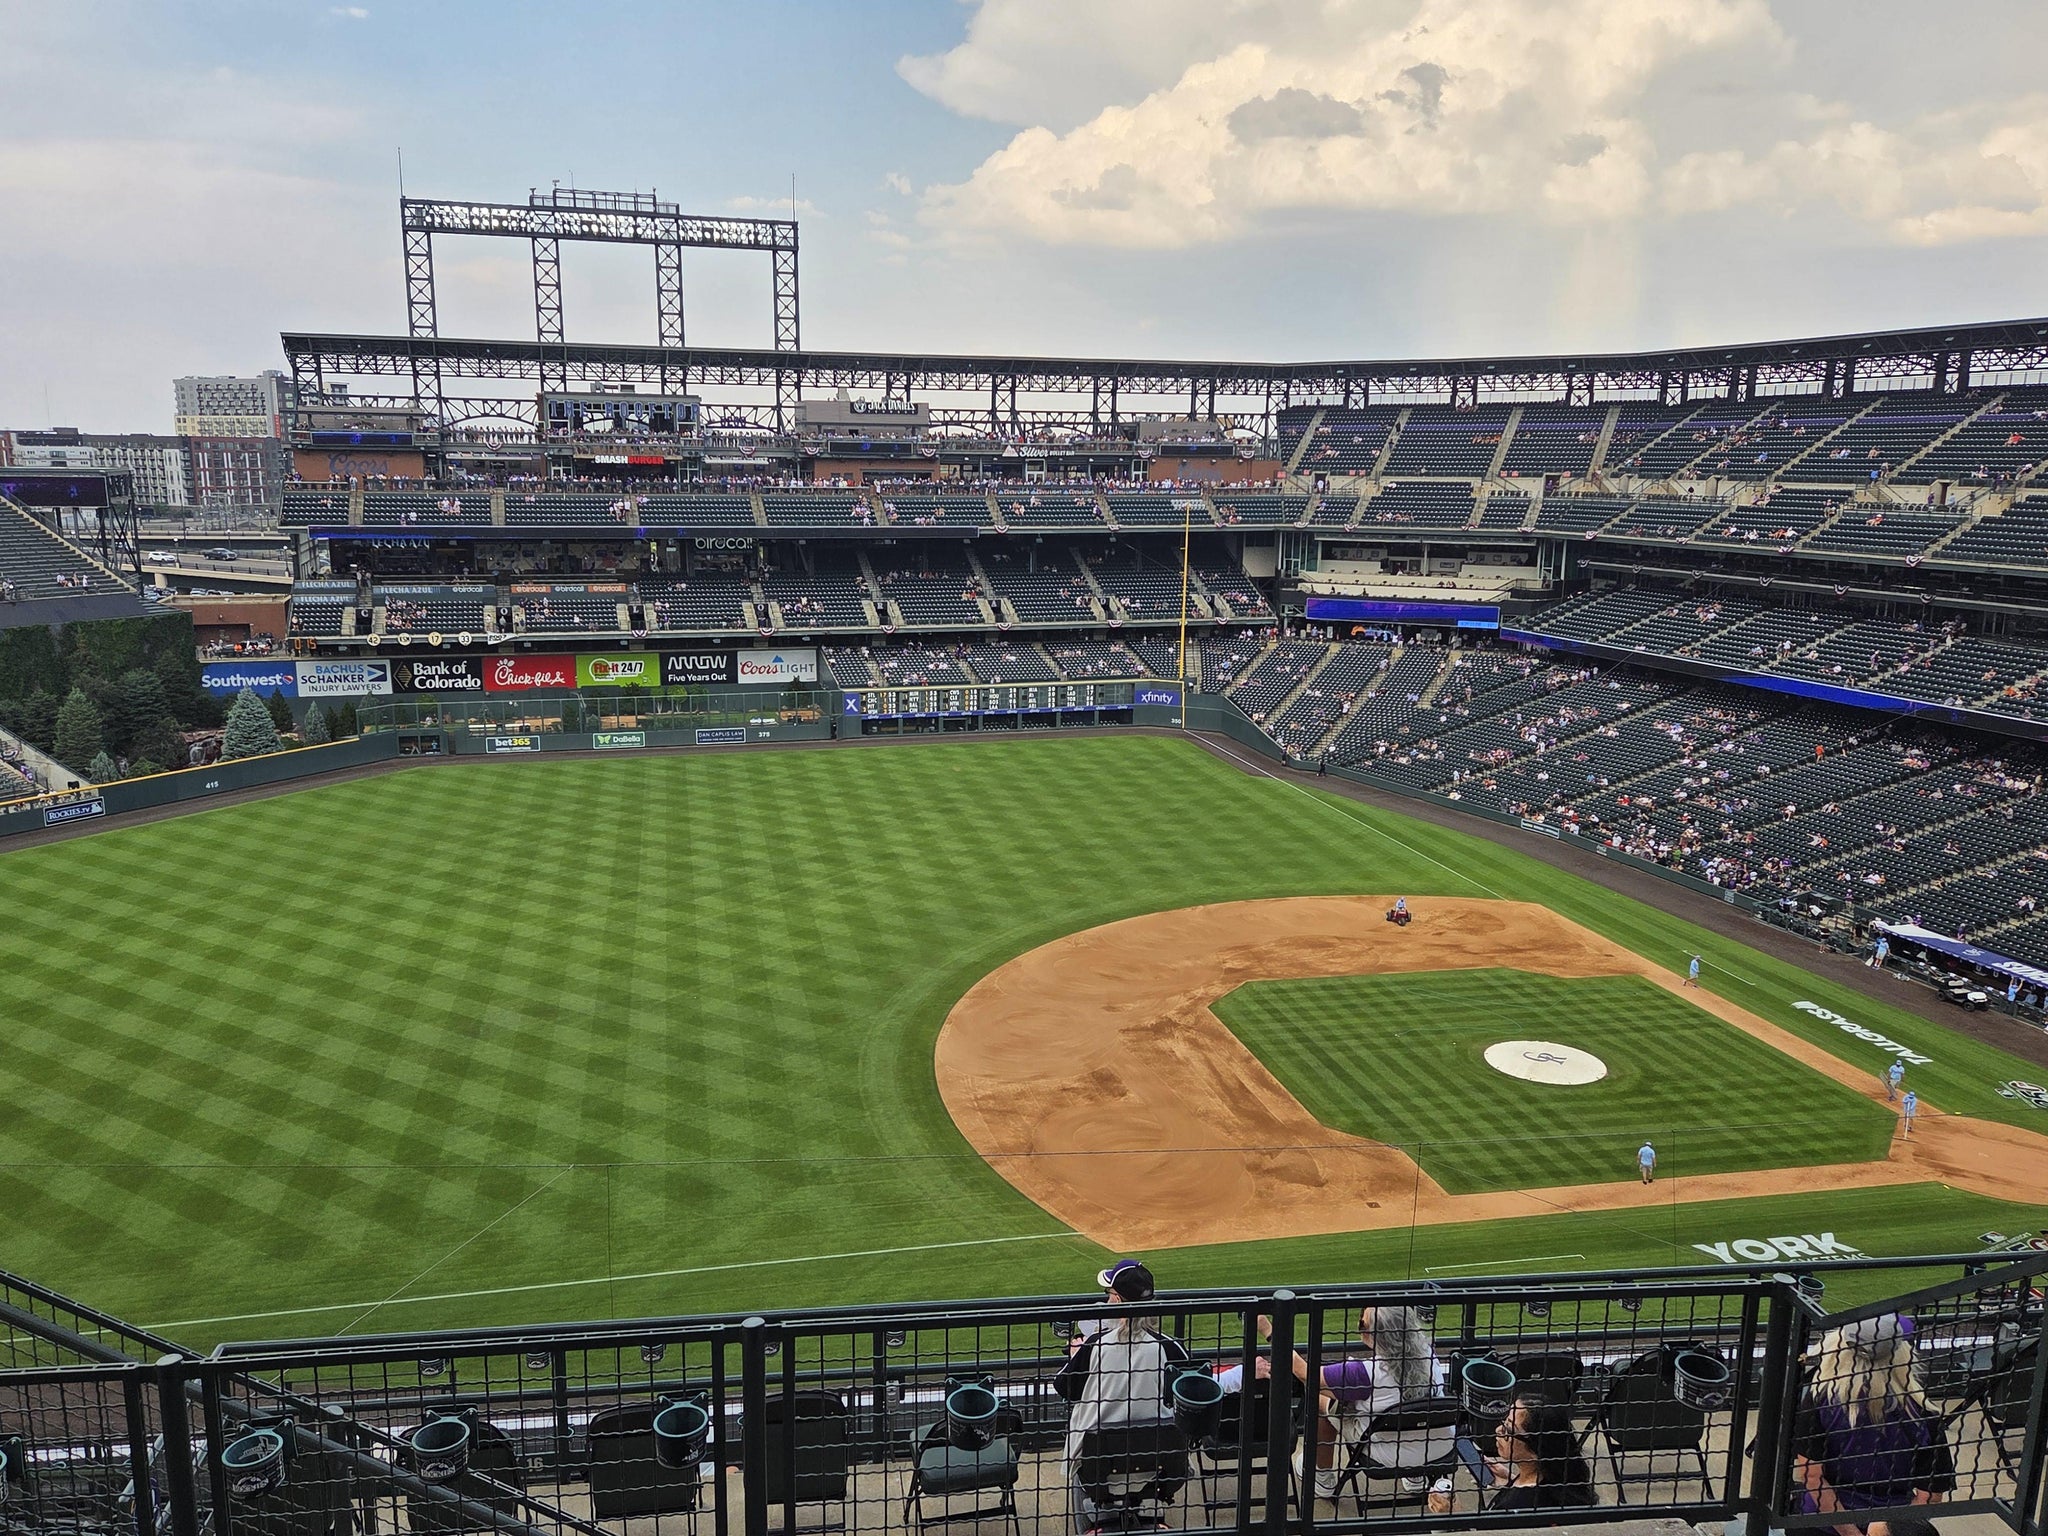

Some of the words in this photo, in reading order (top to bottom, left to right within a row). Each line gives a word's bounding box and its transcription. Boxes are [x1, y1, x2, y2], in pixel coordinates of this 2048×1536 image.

[550, 400, 588, 417] THE
[604, 401, 700, 420] ROOFTOP
[868, 401, 887, 410] JACK
[1020, 446, 1049, 457] Silver
[328, 451, 390, 474] Coors
[595, 455, 664, 464] SMASHBURGER
[381, 586, 410, 594] FLECHA
[412, 586, 433, 594] AZUL
[413, 661, 449, 676] Bank
[452, 660, 468, 675] of
[593, 662, 619, 673] Fix-it
[621, 662, 643, 673] 24/7
[668, 655, 727, 670] ARROW
[740, 660, 778, 675] Coors
[780, 663, 815, 673] LIGHT
[315, 664, 364, 675] BACHUS
[201, 673, 283, 688] Southwest
[301, 674, 365, 684] SCHANKER
[414, 674, 481, 689] Colorado
[668, 673, 686, 682] Five
[687, 673, 710, 682] Years
[711, 672, 727, 680] Out
[308, 684, 339, 692] INJURY
[342, 683, 382, 691] LAWYERS
[1141, 691, 1173, 704] xfinity
[495, 738, 531, 747] bet365
[612, 735, 641, 743] DaBella
[1691, 1232, 1861, 1264] YORK
